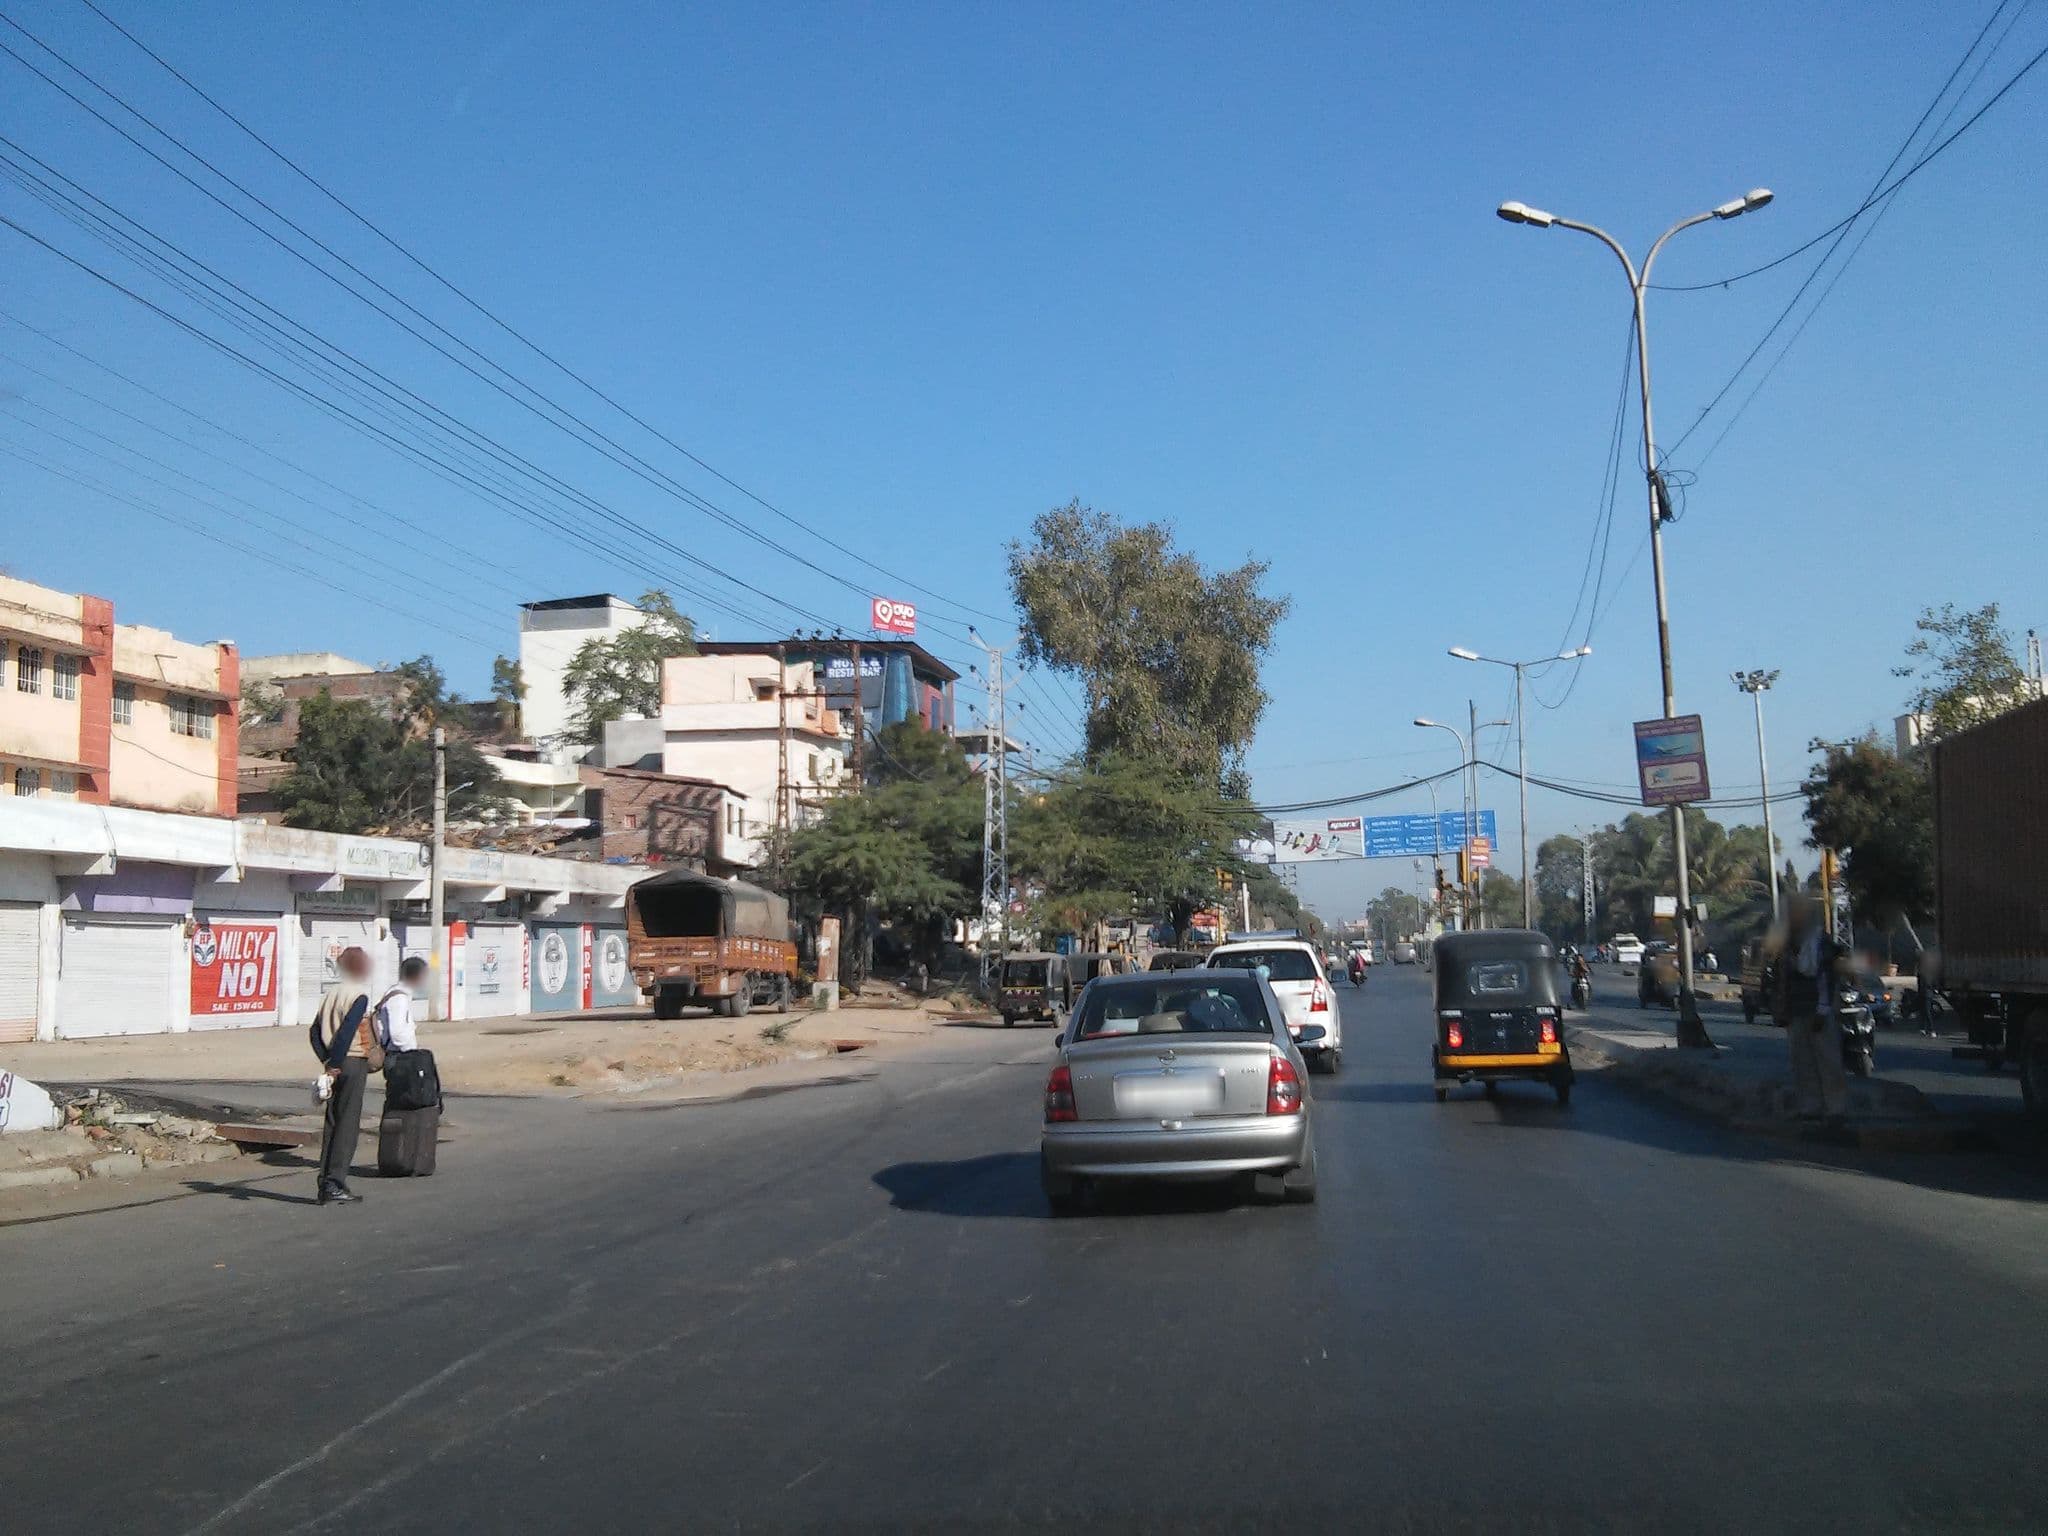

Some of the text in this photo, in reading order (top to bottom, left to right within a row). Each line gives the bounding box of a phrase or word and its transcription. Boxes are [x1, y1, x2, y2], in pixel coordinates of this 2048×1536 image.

[218, 931, 264, 960] MILCY
[584, 929, 592, 990] MRF
[211, 1001, 264, 1012] SAE 15W40
